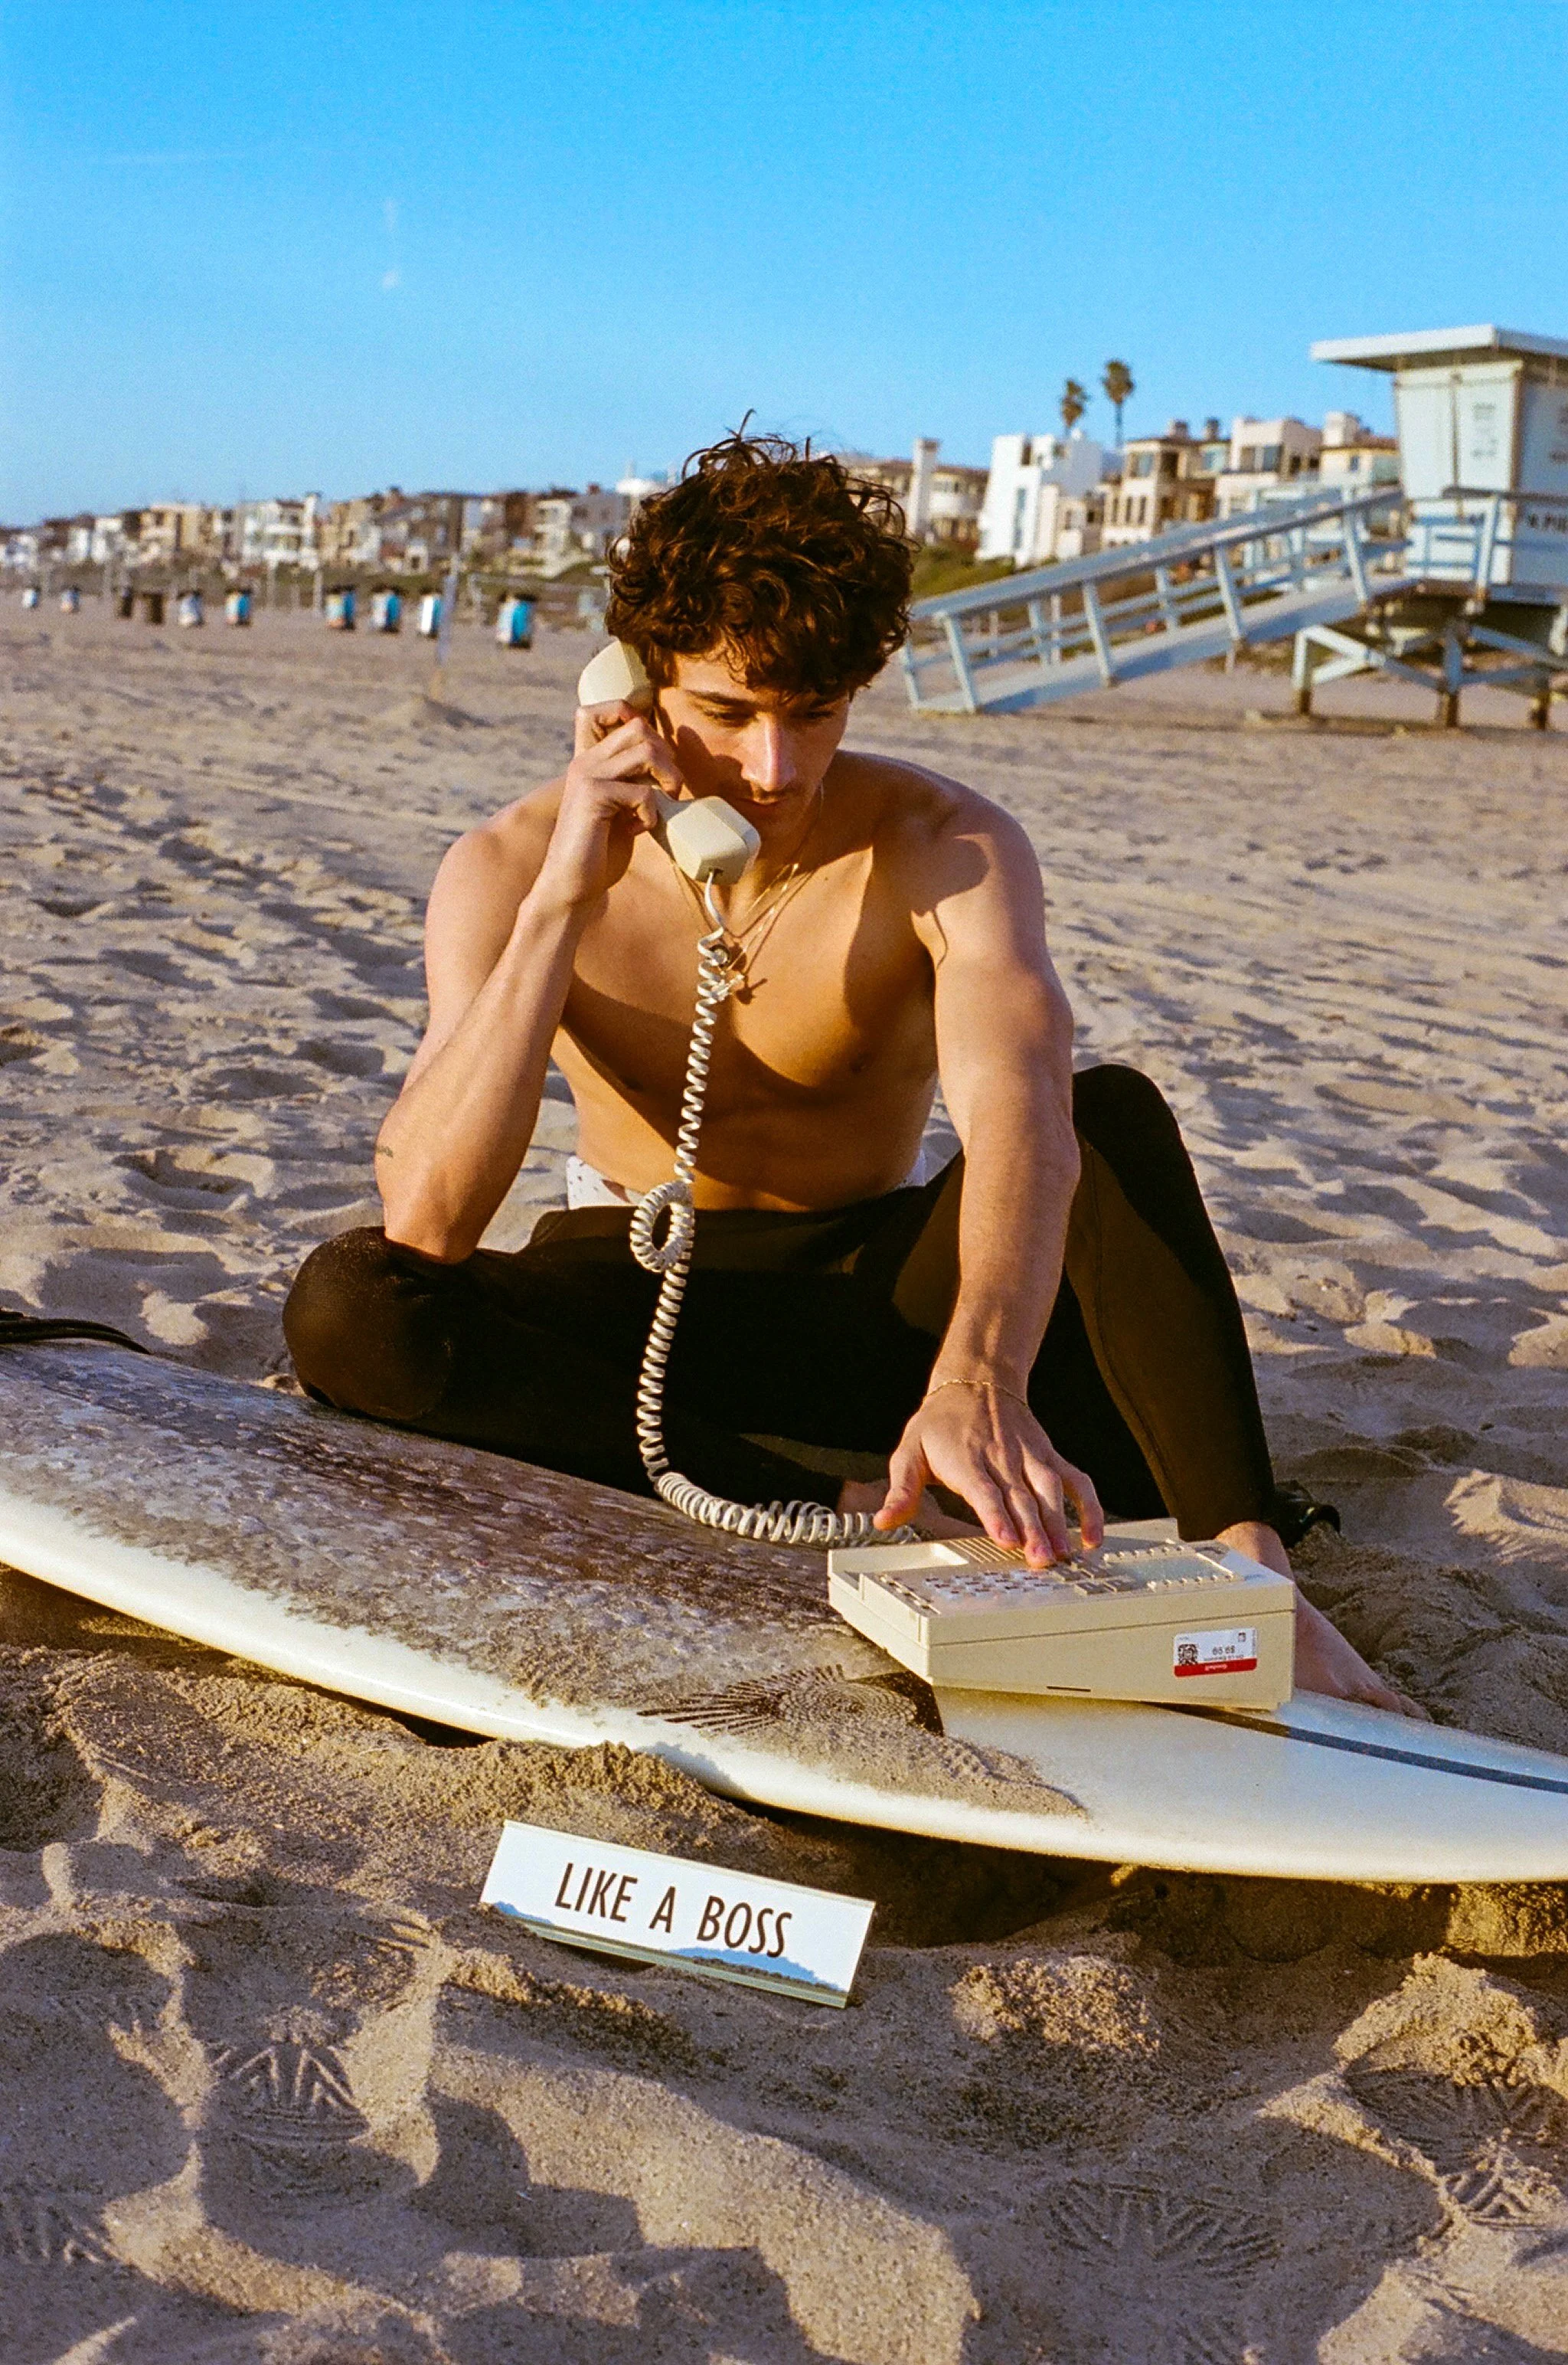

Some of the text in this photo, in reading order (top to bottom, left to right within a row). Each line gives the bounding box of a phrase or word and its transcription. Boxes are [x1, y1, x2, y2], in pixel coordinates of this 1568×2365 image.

[554, 1863, 793, 1958] LIKE A BOSS
